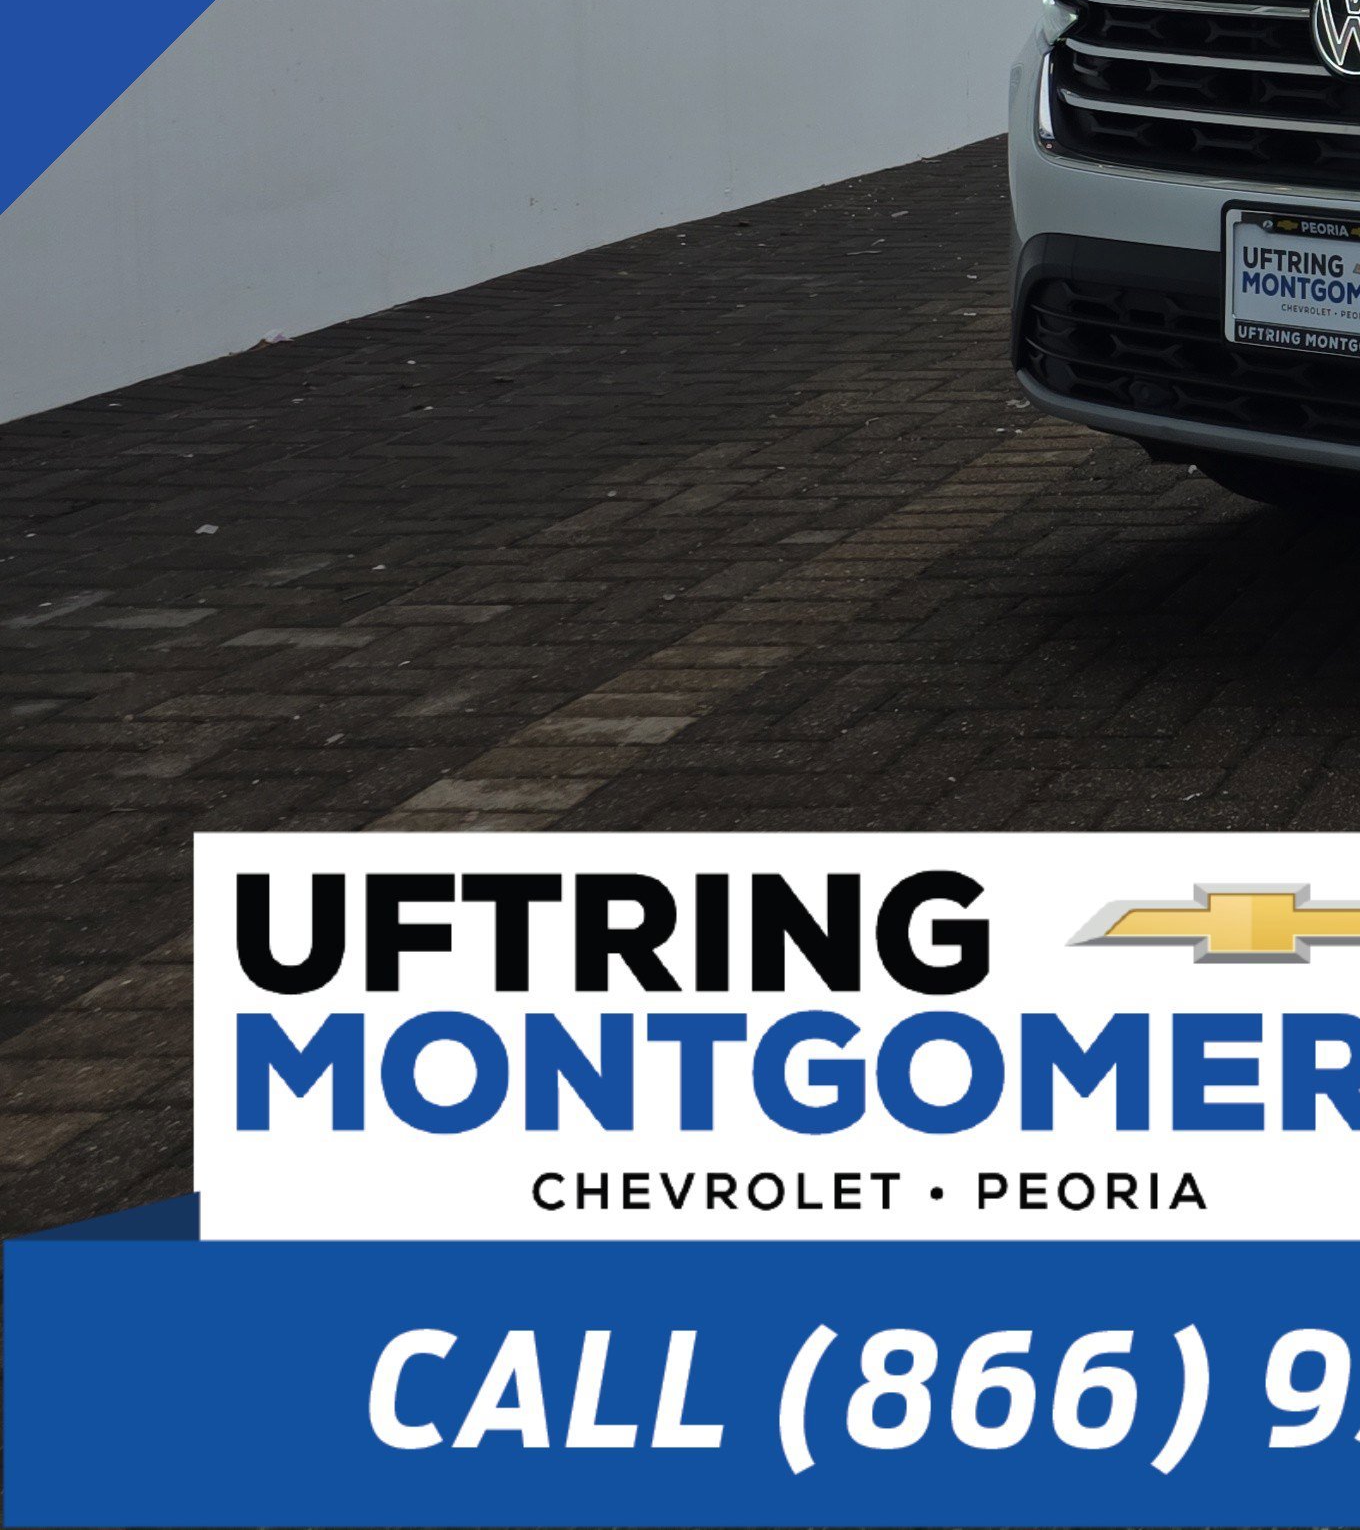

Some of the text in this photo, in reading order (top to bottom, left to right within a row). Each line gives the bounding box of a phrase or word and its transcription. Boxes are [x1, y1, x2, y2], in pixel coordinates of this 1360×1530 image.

[1301, 221, 1349, 237] PEORIA
[1243, 246, 1344, 278] UFTRING
[1281, 303, 1331, 316] CHEVROLET
[1238, 324, 1301, 345] UFTRING
